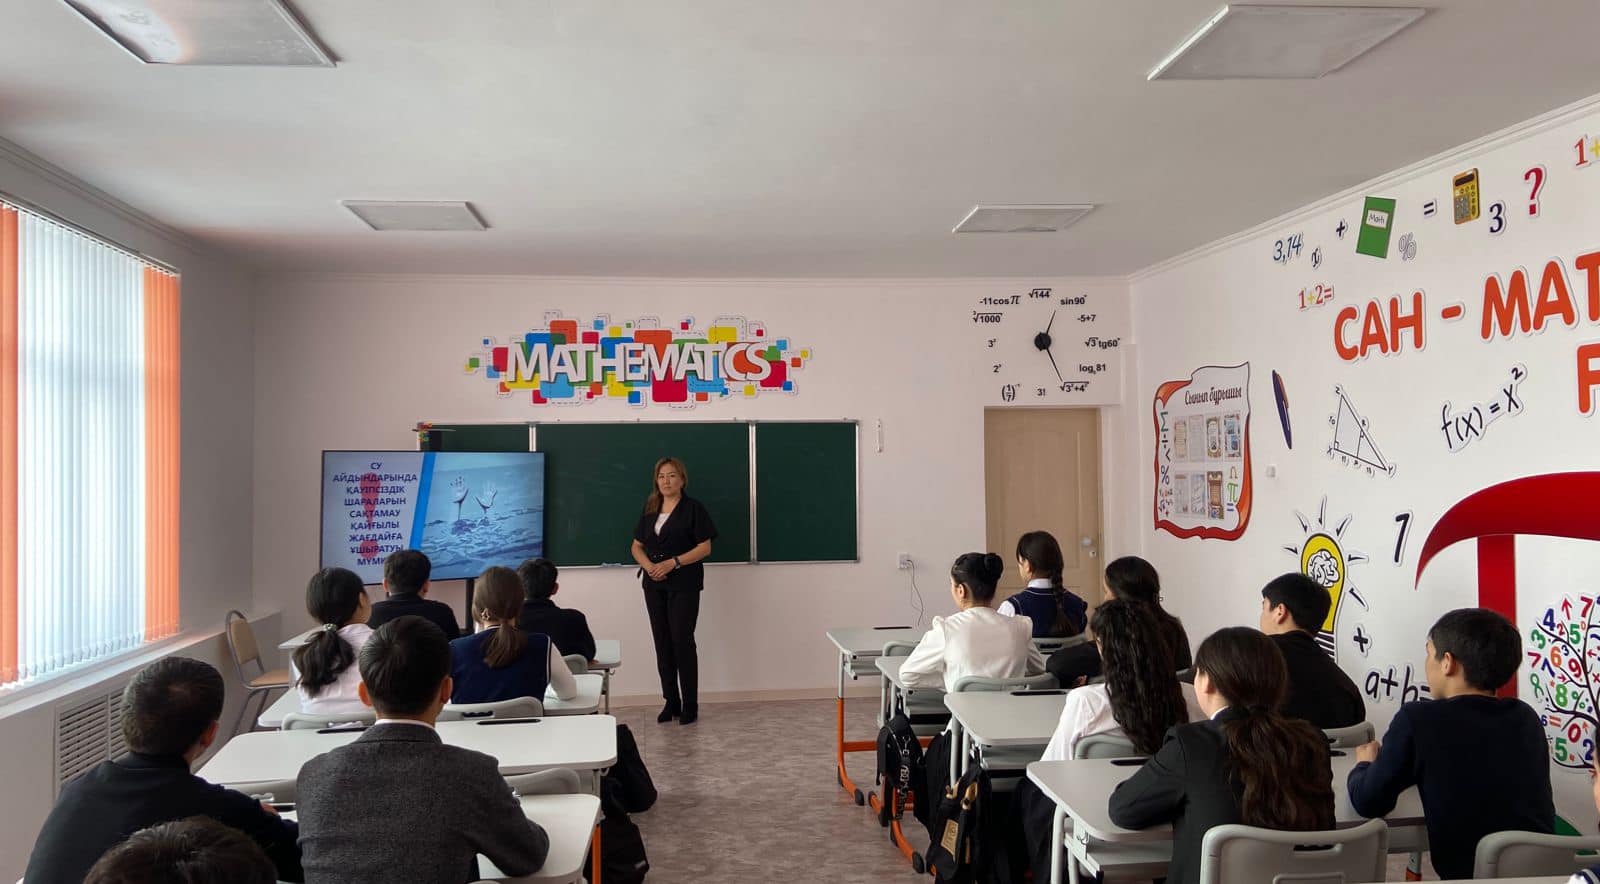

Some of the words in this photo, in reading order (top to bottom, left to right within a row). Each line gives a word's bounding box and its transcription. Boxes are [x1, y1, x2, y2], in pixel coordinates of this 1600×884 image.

[1524, 168, 1543, 215] ?
[1368, 214, 1386, 224] Math
[1489, 204, 1503, 233] 3
[1273, 235, 1302, 262] 3,14
[1298, 284, 1333, 309] 1+2=
[1077, 314, 1096, 322] -5+7
[1334, 292, 1423, 360] САН
[507, 342, 772, 382] MATHEMATICS
[370, 462, 383, 470] СУ
[332, 472, 418, 483] АЙДЫНДАРЫНДА
[344, 497, 407, 506] ШАРАЛАРЫН
[1580, 596, 1594, 618] 7
[1543, 608, 1556, 631] 4
[1557, 623, 1565, 636] 2
[1531, 629, 1546, 649] 3
[1569, 624, 1581, 644] 5
[1528, 652, 1541, 668] 7
[1550, 646, 1562, 668] 6
[1561, 645, 1570, 656] 3
[1568, 658, 1582, 678] 9
[1555, 683, 1568, 707] 8
[1554, 737, 1568, 761] 5
